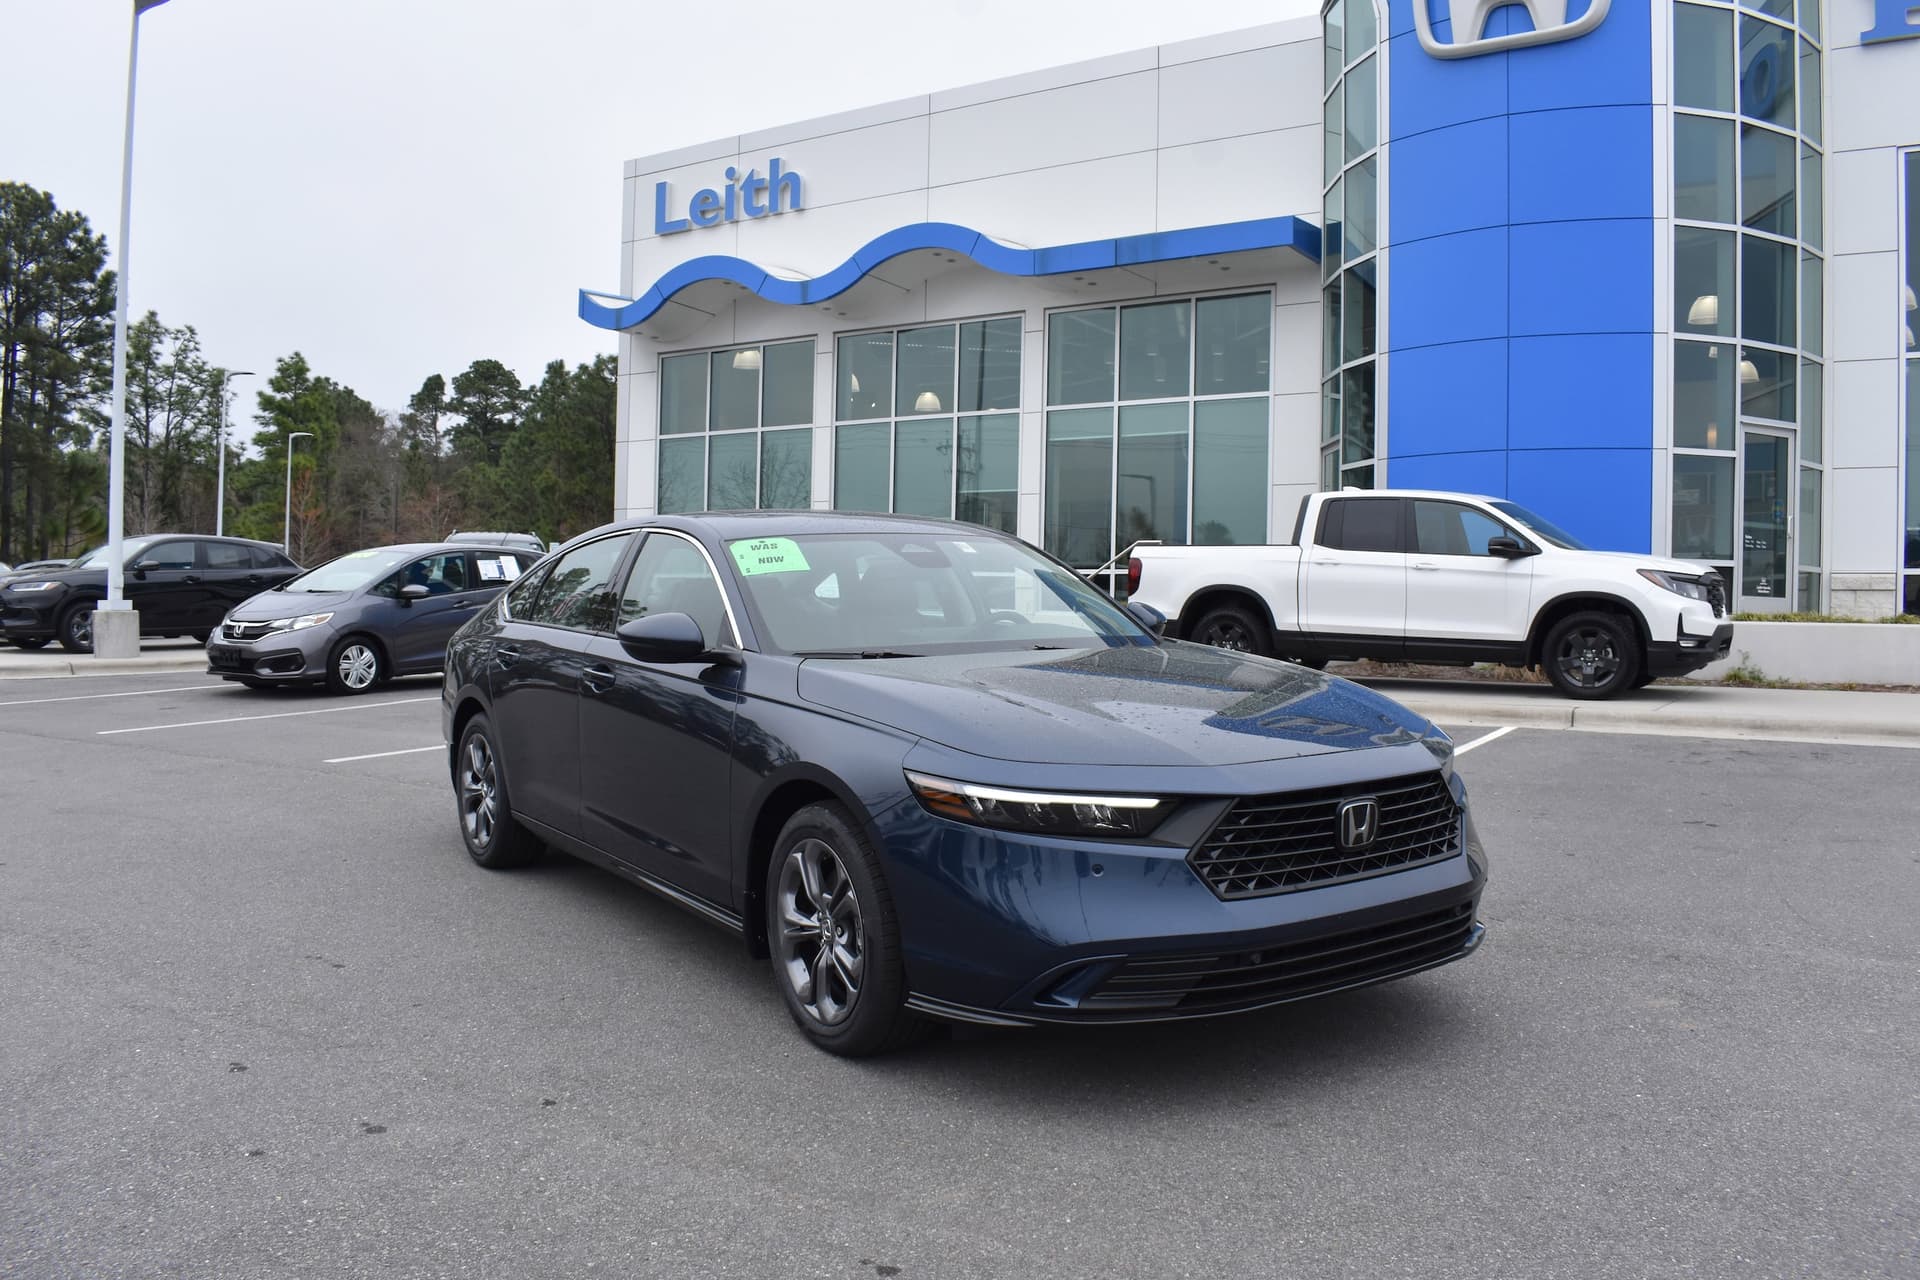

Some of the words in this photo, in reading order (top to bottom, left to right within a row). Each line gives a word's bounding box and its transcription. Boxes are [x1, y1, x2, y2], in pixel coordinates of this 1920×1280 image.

[654, 157, 803, 235] Leith
[750, 543, 778, 551] WAS
[758, 555, 784, 564] NOW
